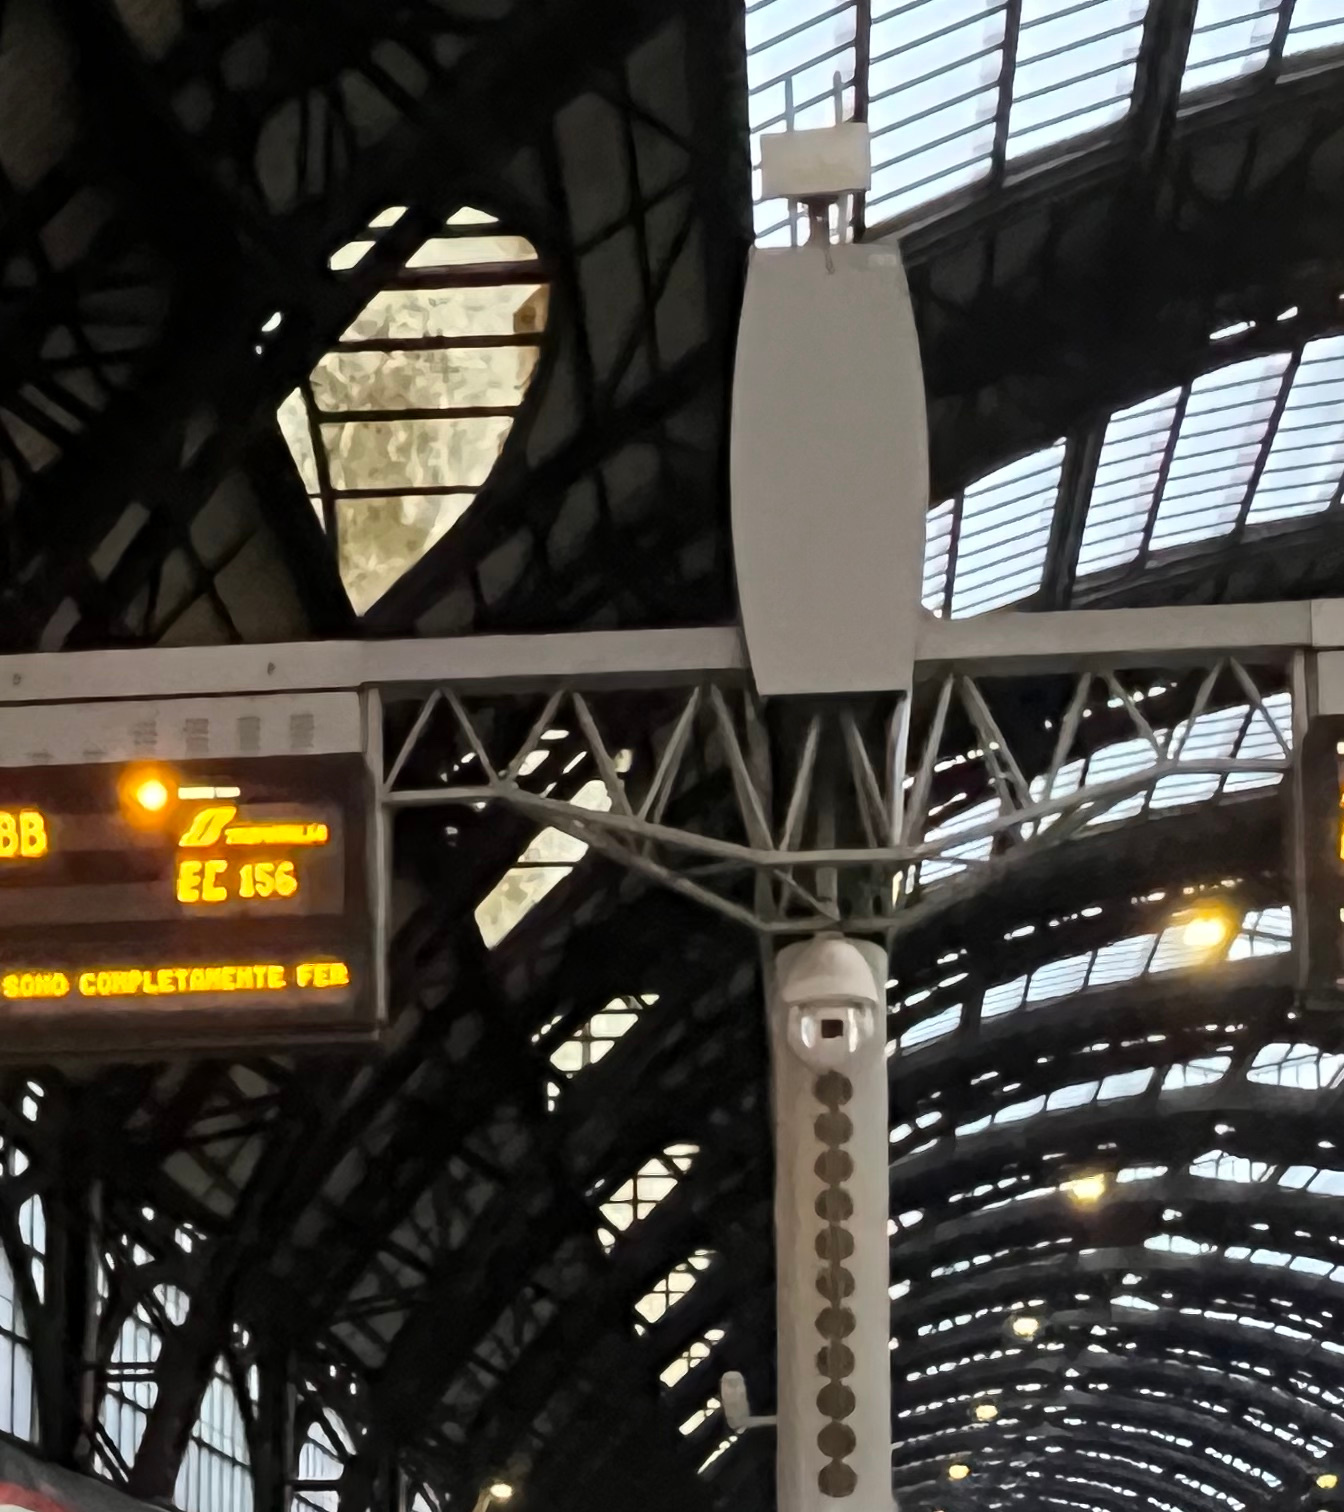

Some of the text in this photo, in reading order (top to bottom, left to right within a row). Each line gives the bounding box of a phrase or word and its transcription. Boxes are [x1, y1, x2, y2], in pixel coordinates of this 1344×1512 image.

[176, 858, 297, 902] EC 156
[0, 972, 70, 998] SONO
[76, 965, 286, 996] COMPLETAMENTE
